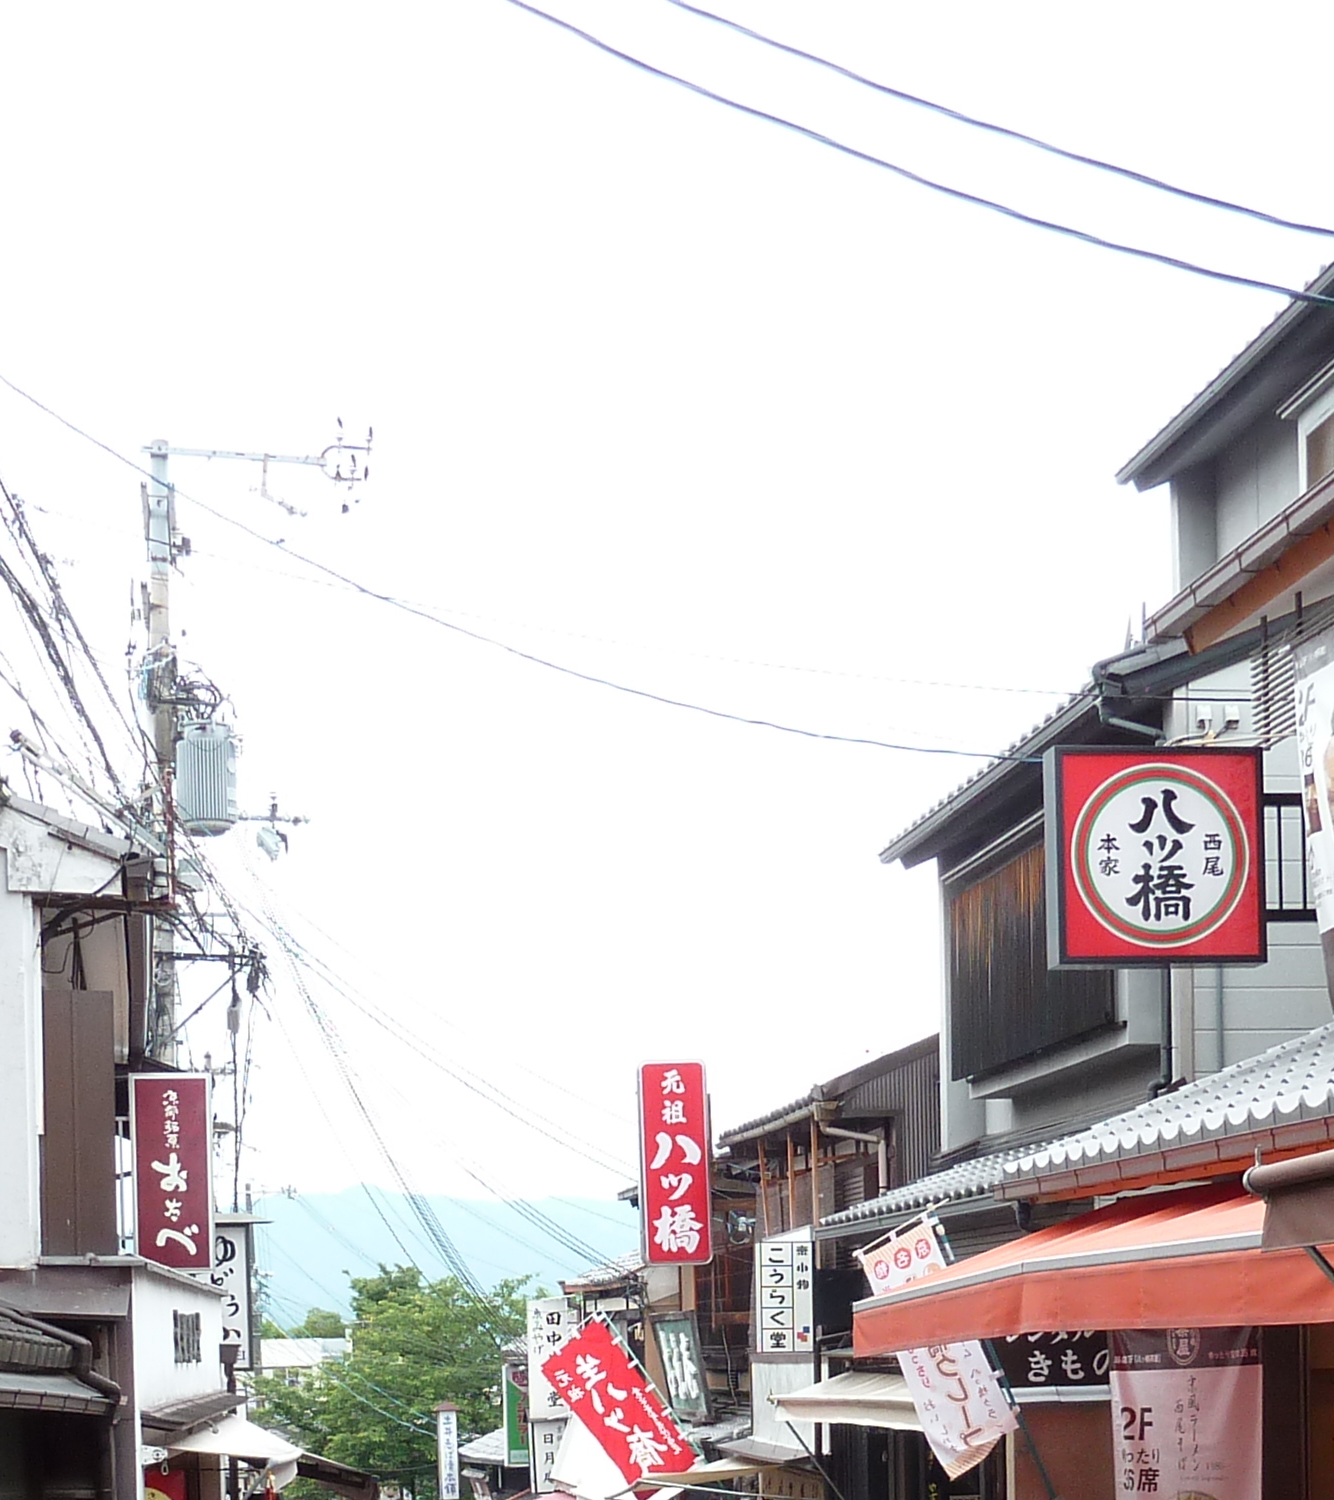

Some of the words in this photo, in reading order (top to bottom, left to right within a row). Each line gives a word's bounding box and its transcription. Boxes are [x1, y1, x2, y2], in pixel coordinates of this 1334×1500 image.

[1097, 833, 1121, 877] 本家
[1125, 788, 1196, 922] 八ツ橋
[1202, 833, 1224, 876] 西尾
[796, 1246, 809, 1290] 京小物
[768, 1247, 786, 1350] こうらく堂
[1120, 1406, 1154, 1441] 2F
